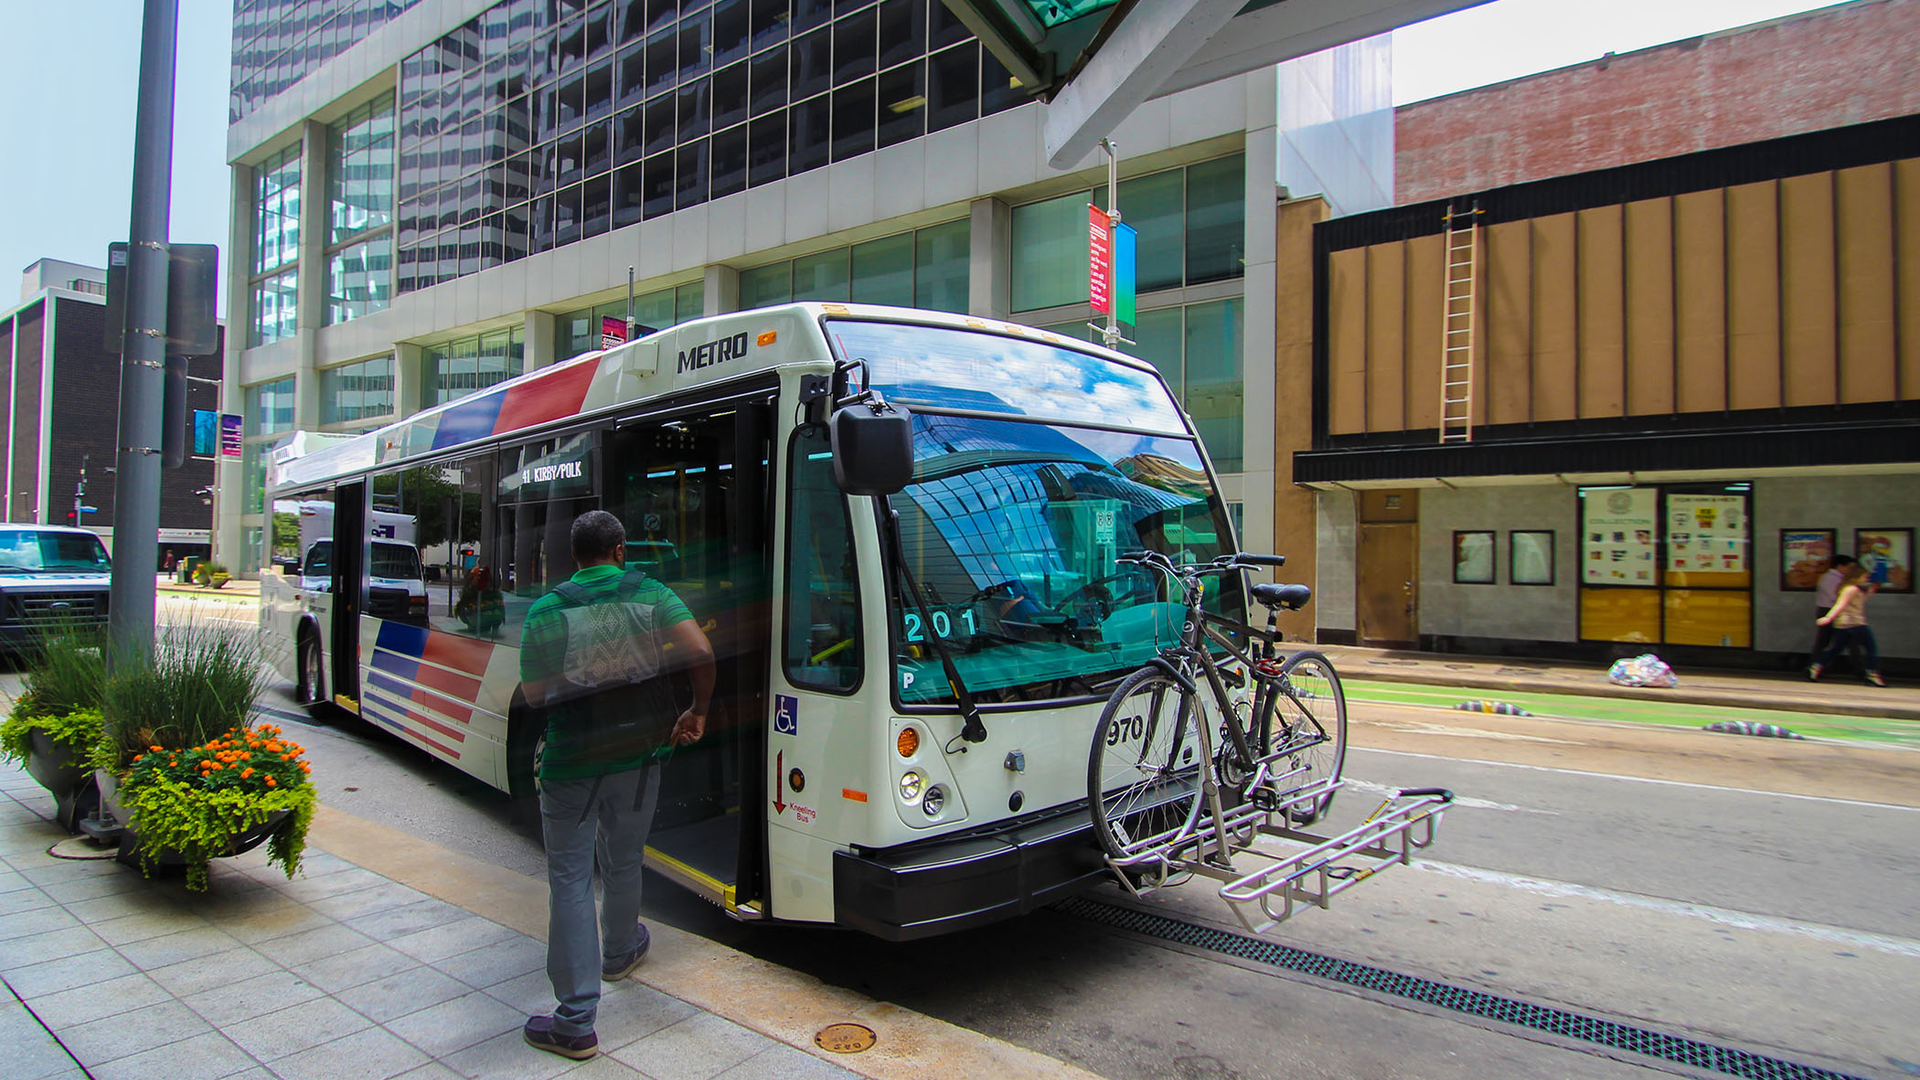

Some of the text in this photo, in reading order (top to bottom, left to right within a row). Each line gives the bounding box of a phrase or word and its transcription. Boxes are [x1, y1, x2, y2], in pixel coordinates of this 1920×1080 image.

[677, 331, 748, 374] METRO
[522, 461, 582, 484] 41 KIRBY/POLK
[903, 672, 915, 689] P
[790, 802, 816, 819] Kneeling
[797, 812, 809, 823] Bus
